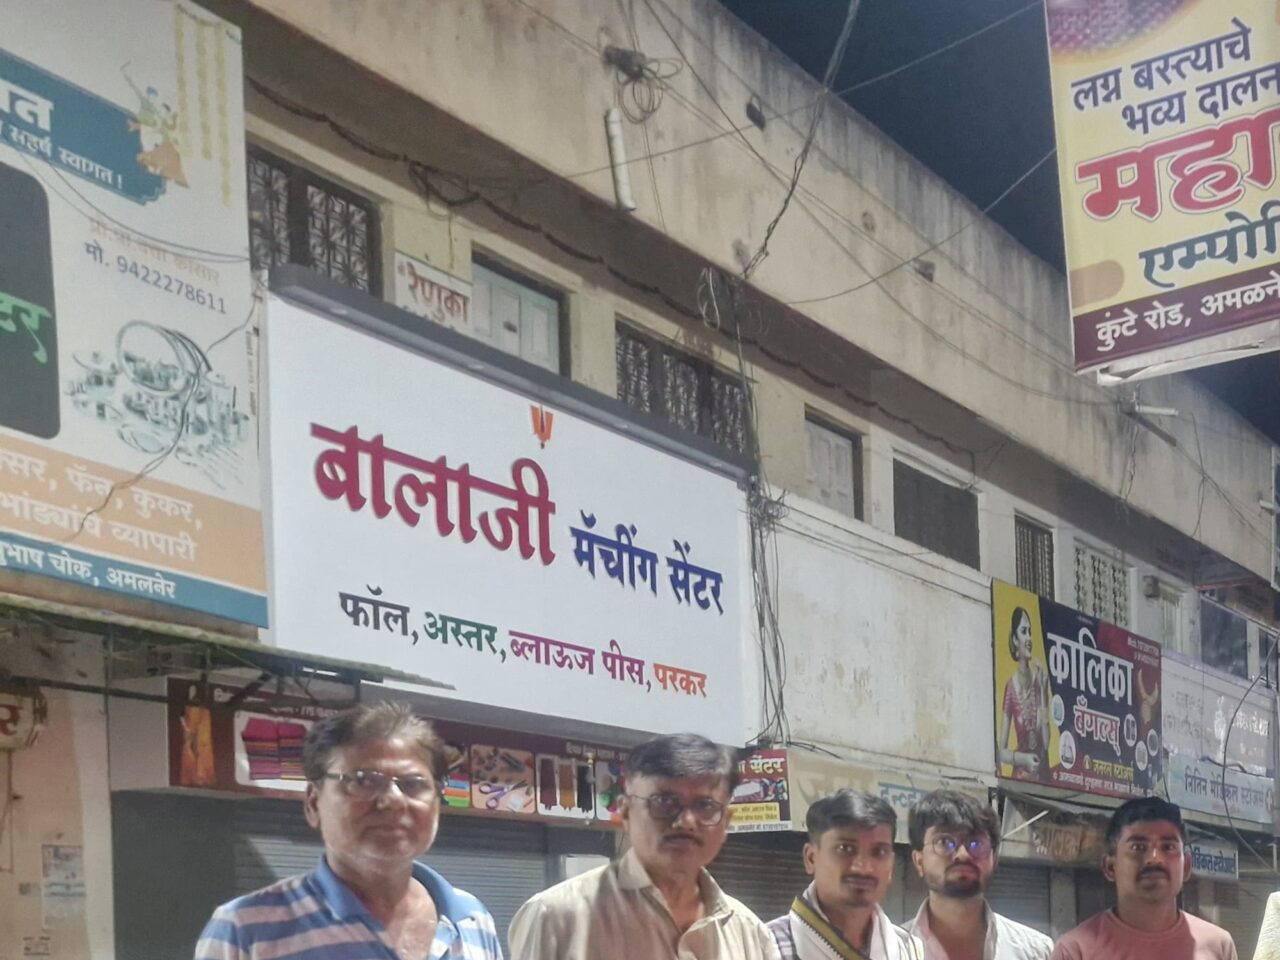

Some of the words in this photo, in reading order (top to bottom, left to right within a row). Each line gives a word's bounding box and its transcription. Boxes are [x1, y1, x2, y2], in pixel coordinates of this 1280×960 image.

[1072, 67, 1123, 110] लग्न
[1132, 17, 1252, 91] बस्त्याचे
[1122, 90, 1187, 135] भव्य
[84, 240, 110, 267] मो.
[116, 255, 227, 314] 9422278611
[406, 261, 470, 324] रेणुका
[1096, 305, 1138, 350] कुंटे
[1144, 295, 1191, 329] रोड,
[107, 520, 198, 562] व्यापारी
[310, 422, 556, 566] बालाजी
[568, 509, 658, 595] मॅचींग
[666, 538, 725, 614] सेंटर
[338, 583, 419, 645] फॉल,
[422, 610, 507, 662] अस्तर,
[508, 629, 596, 675] ब्लाऊज
[601, 640, 652, 692] पीस,
[653, 661, 708, 699] परकर
[1046, 627, 1134, 706] कालिका
[1184, 764, 1208, 796] नितिन
